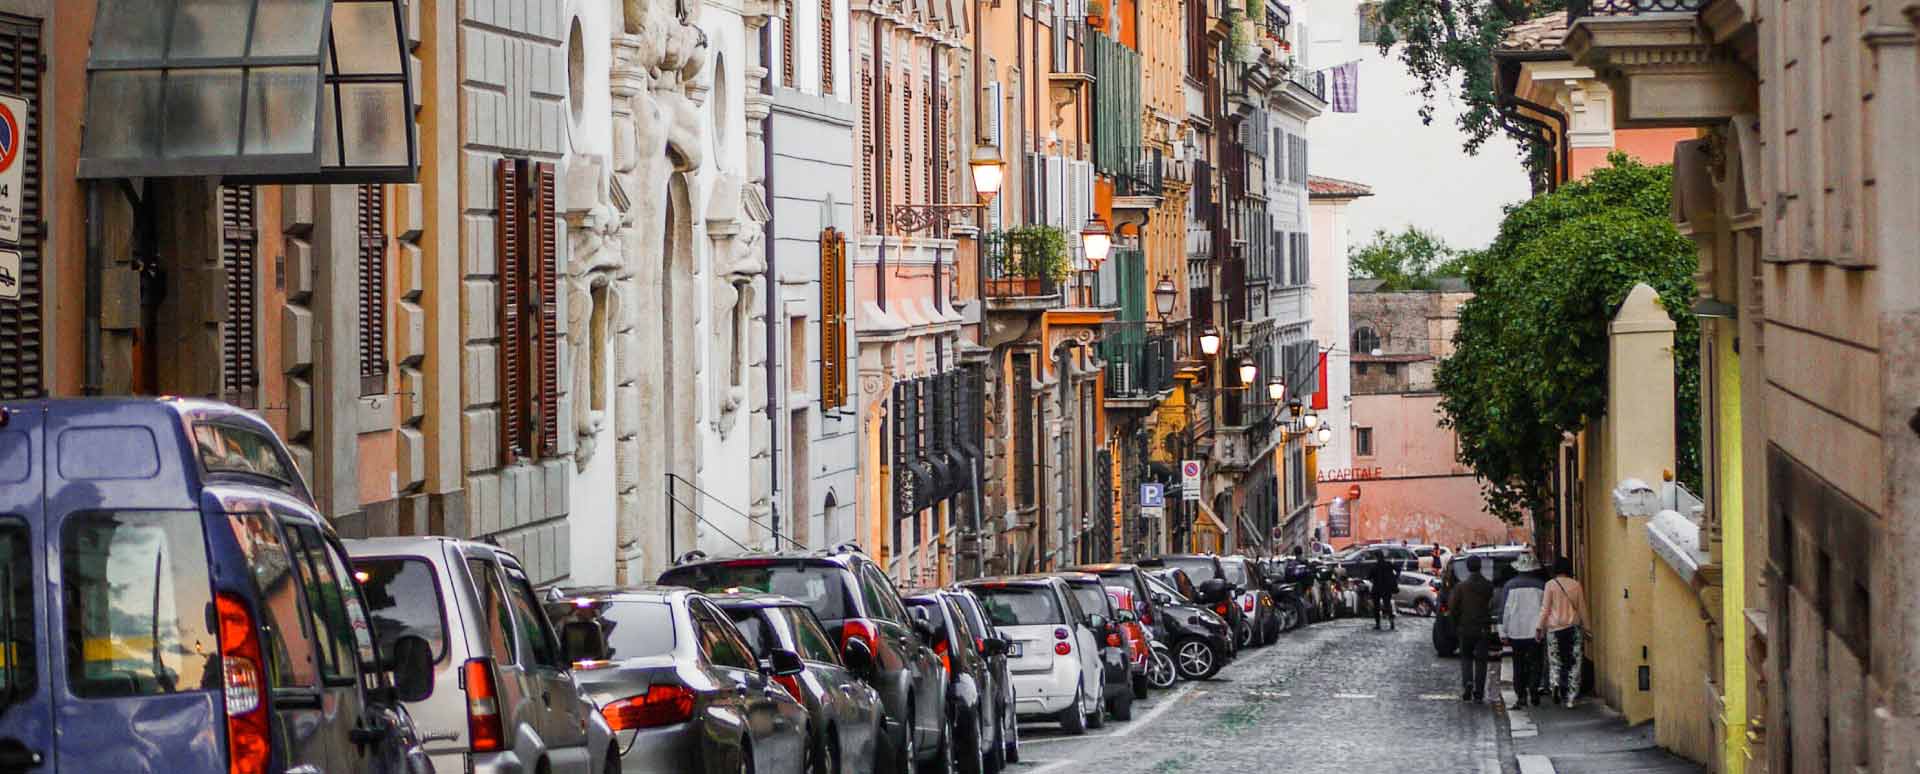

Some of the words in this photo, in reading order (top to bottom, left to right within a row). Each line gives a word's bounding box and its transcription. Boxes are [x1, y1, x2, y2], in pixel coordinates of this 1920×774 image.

[0, 184, 8, 198] 4
[1328, 466, 1382, 480] CAPITALE
[1145, 486, 1158, 503] P
